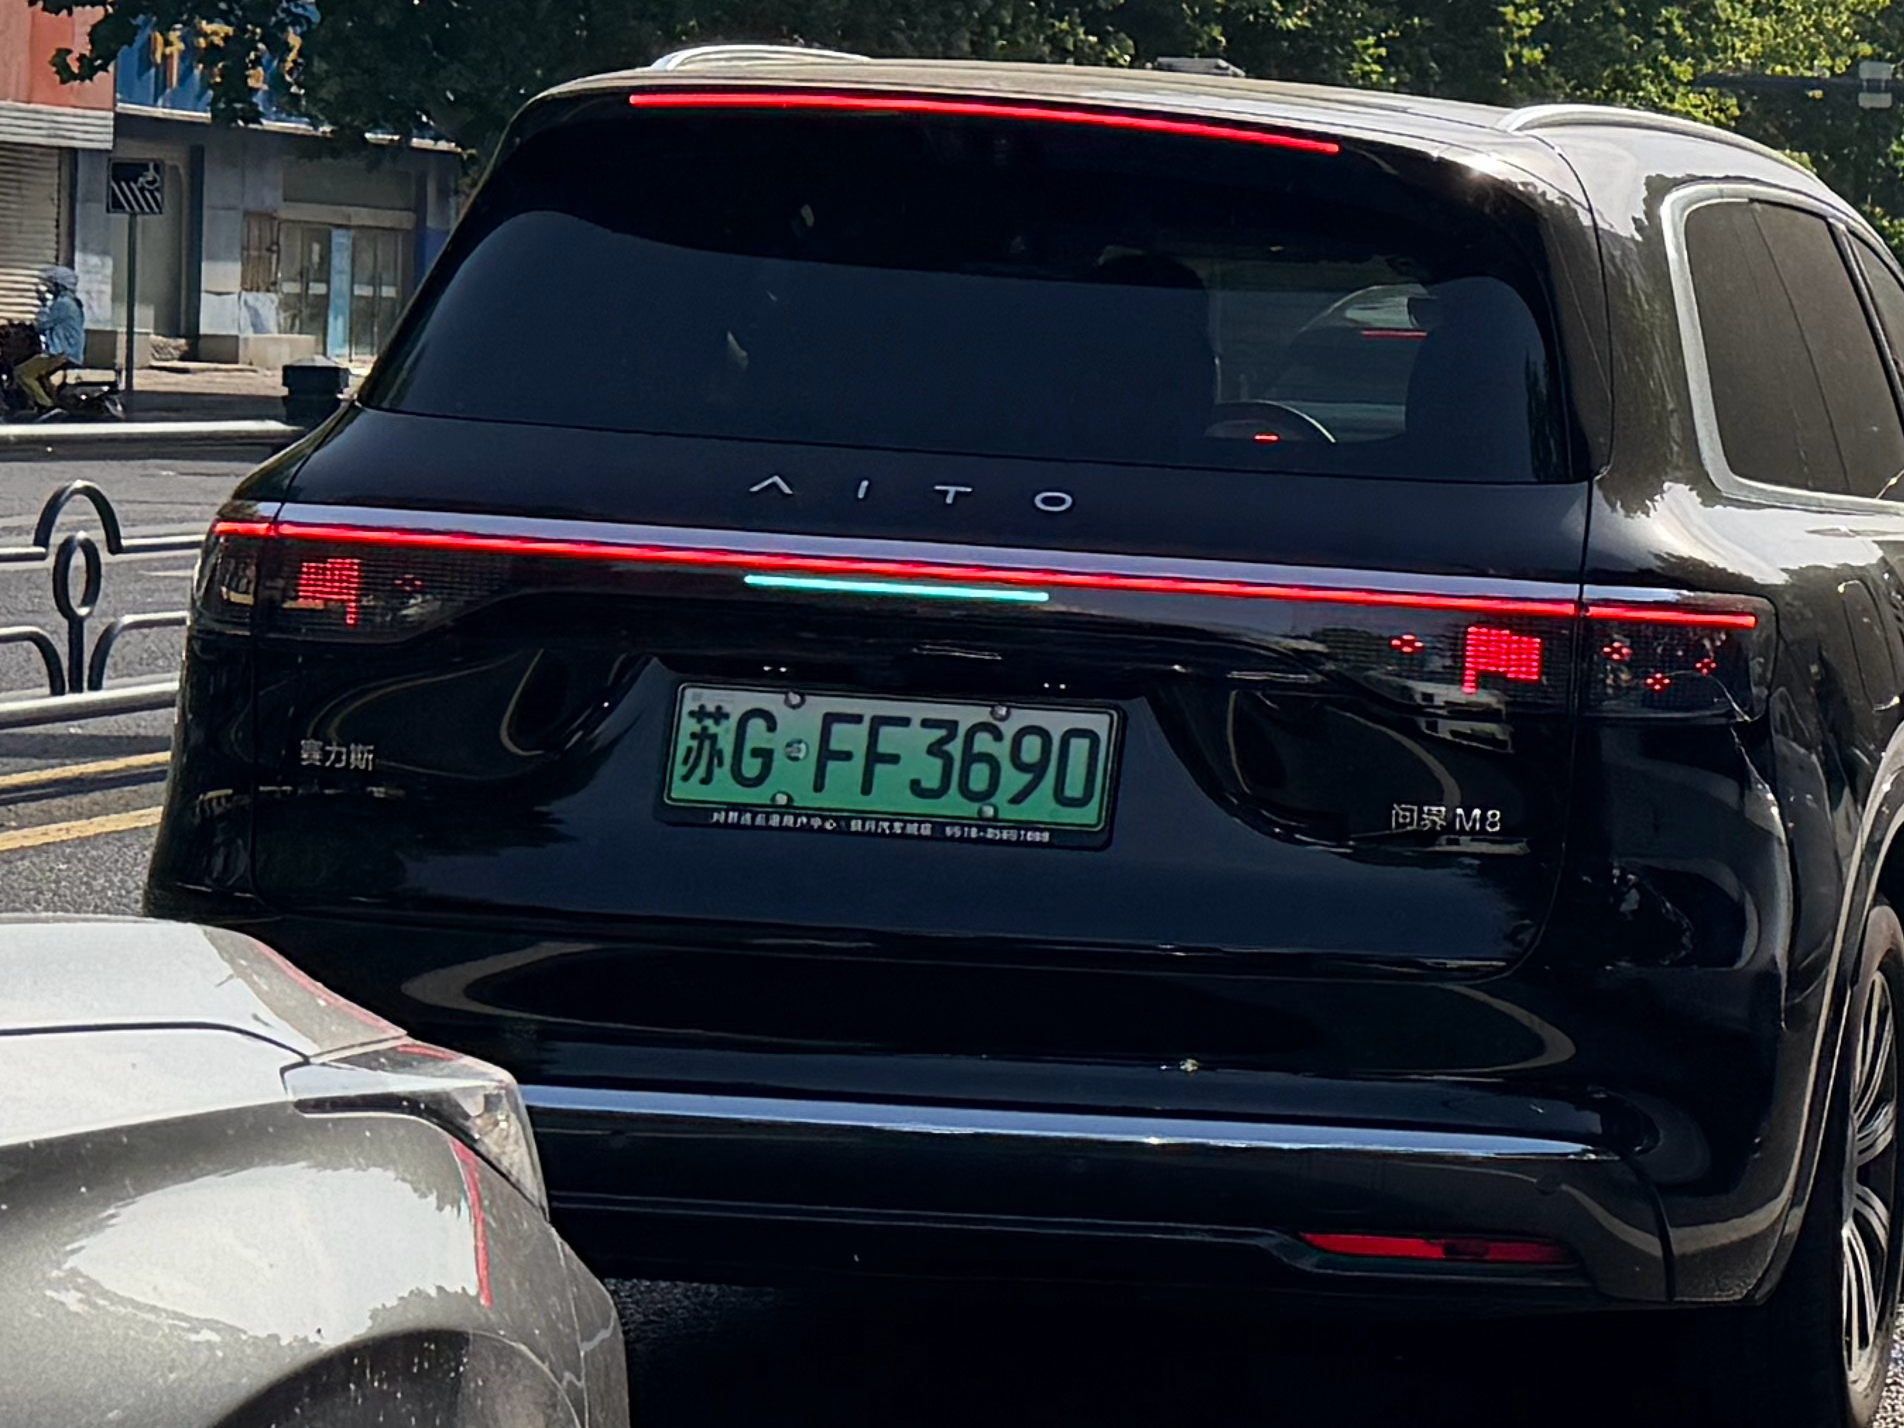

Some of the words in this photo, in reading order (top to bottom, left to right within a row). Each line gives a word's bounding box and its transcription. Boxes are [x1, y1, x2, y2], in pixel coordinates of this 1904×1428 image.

[749, 475, 1073, 512] AITO
[301, 738, 374, 771] 赛力斯
[1391, 803, 1447, 831] 问界
[1455, 807, 1501, 832] M8
